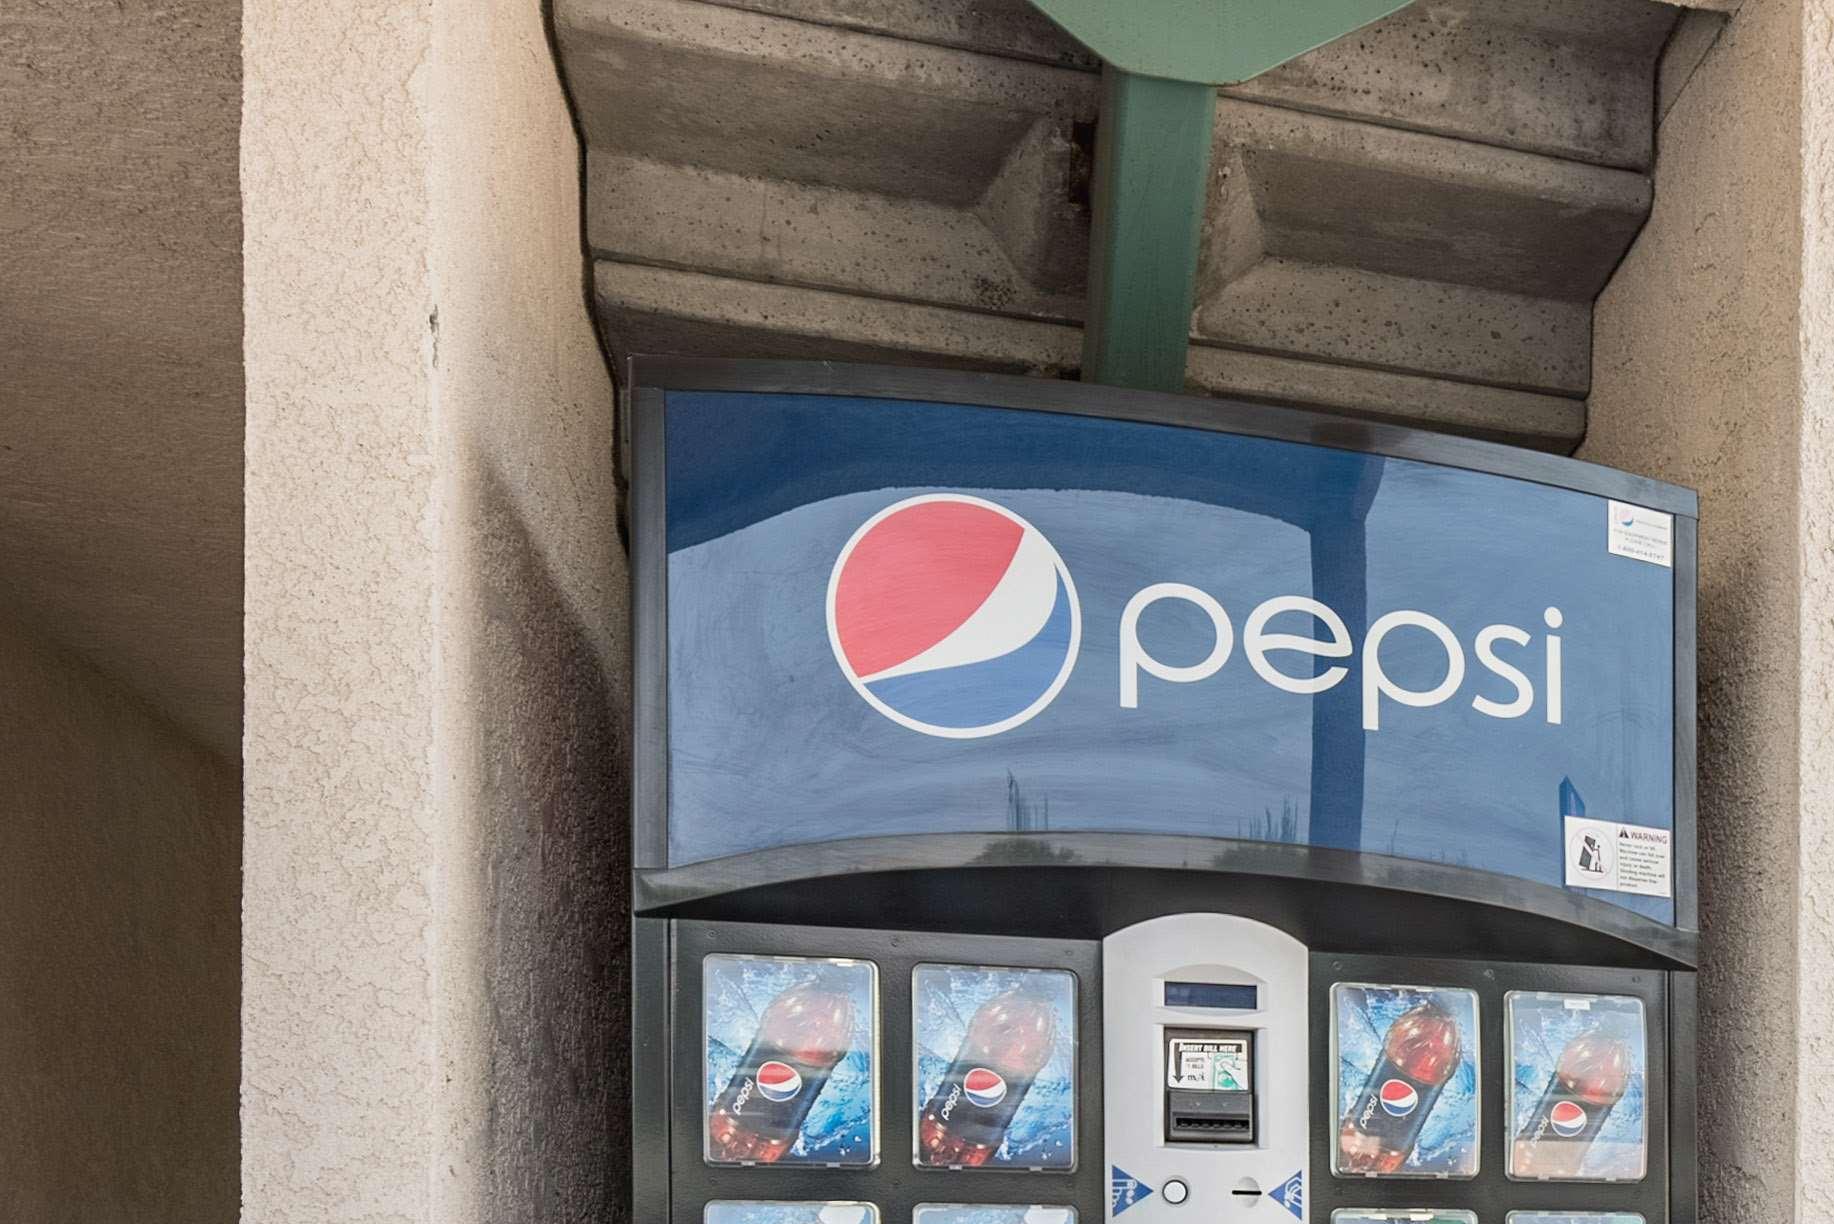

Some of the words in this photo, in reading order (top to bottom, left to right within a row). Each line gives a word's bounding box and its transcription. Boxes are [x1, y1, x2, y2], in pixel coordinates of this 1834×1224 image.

[1120, 582, 1562, 732] pepsi
[1631, 831, 1668, 845] WARNING
[732, 1077, 754, 1115] pepsi
[941, 1083, 961, 1120] pepsi
[1360, 1094, 1378, 1129] pepsi
[1530, 1115, 1549, 1148] pepsi
